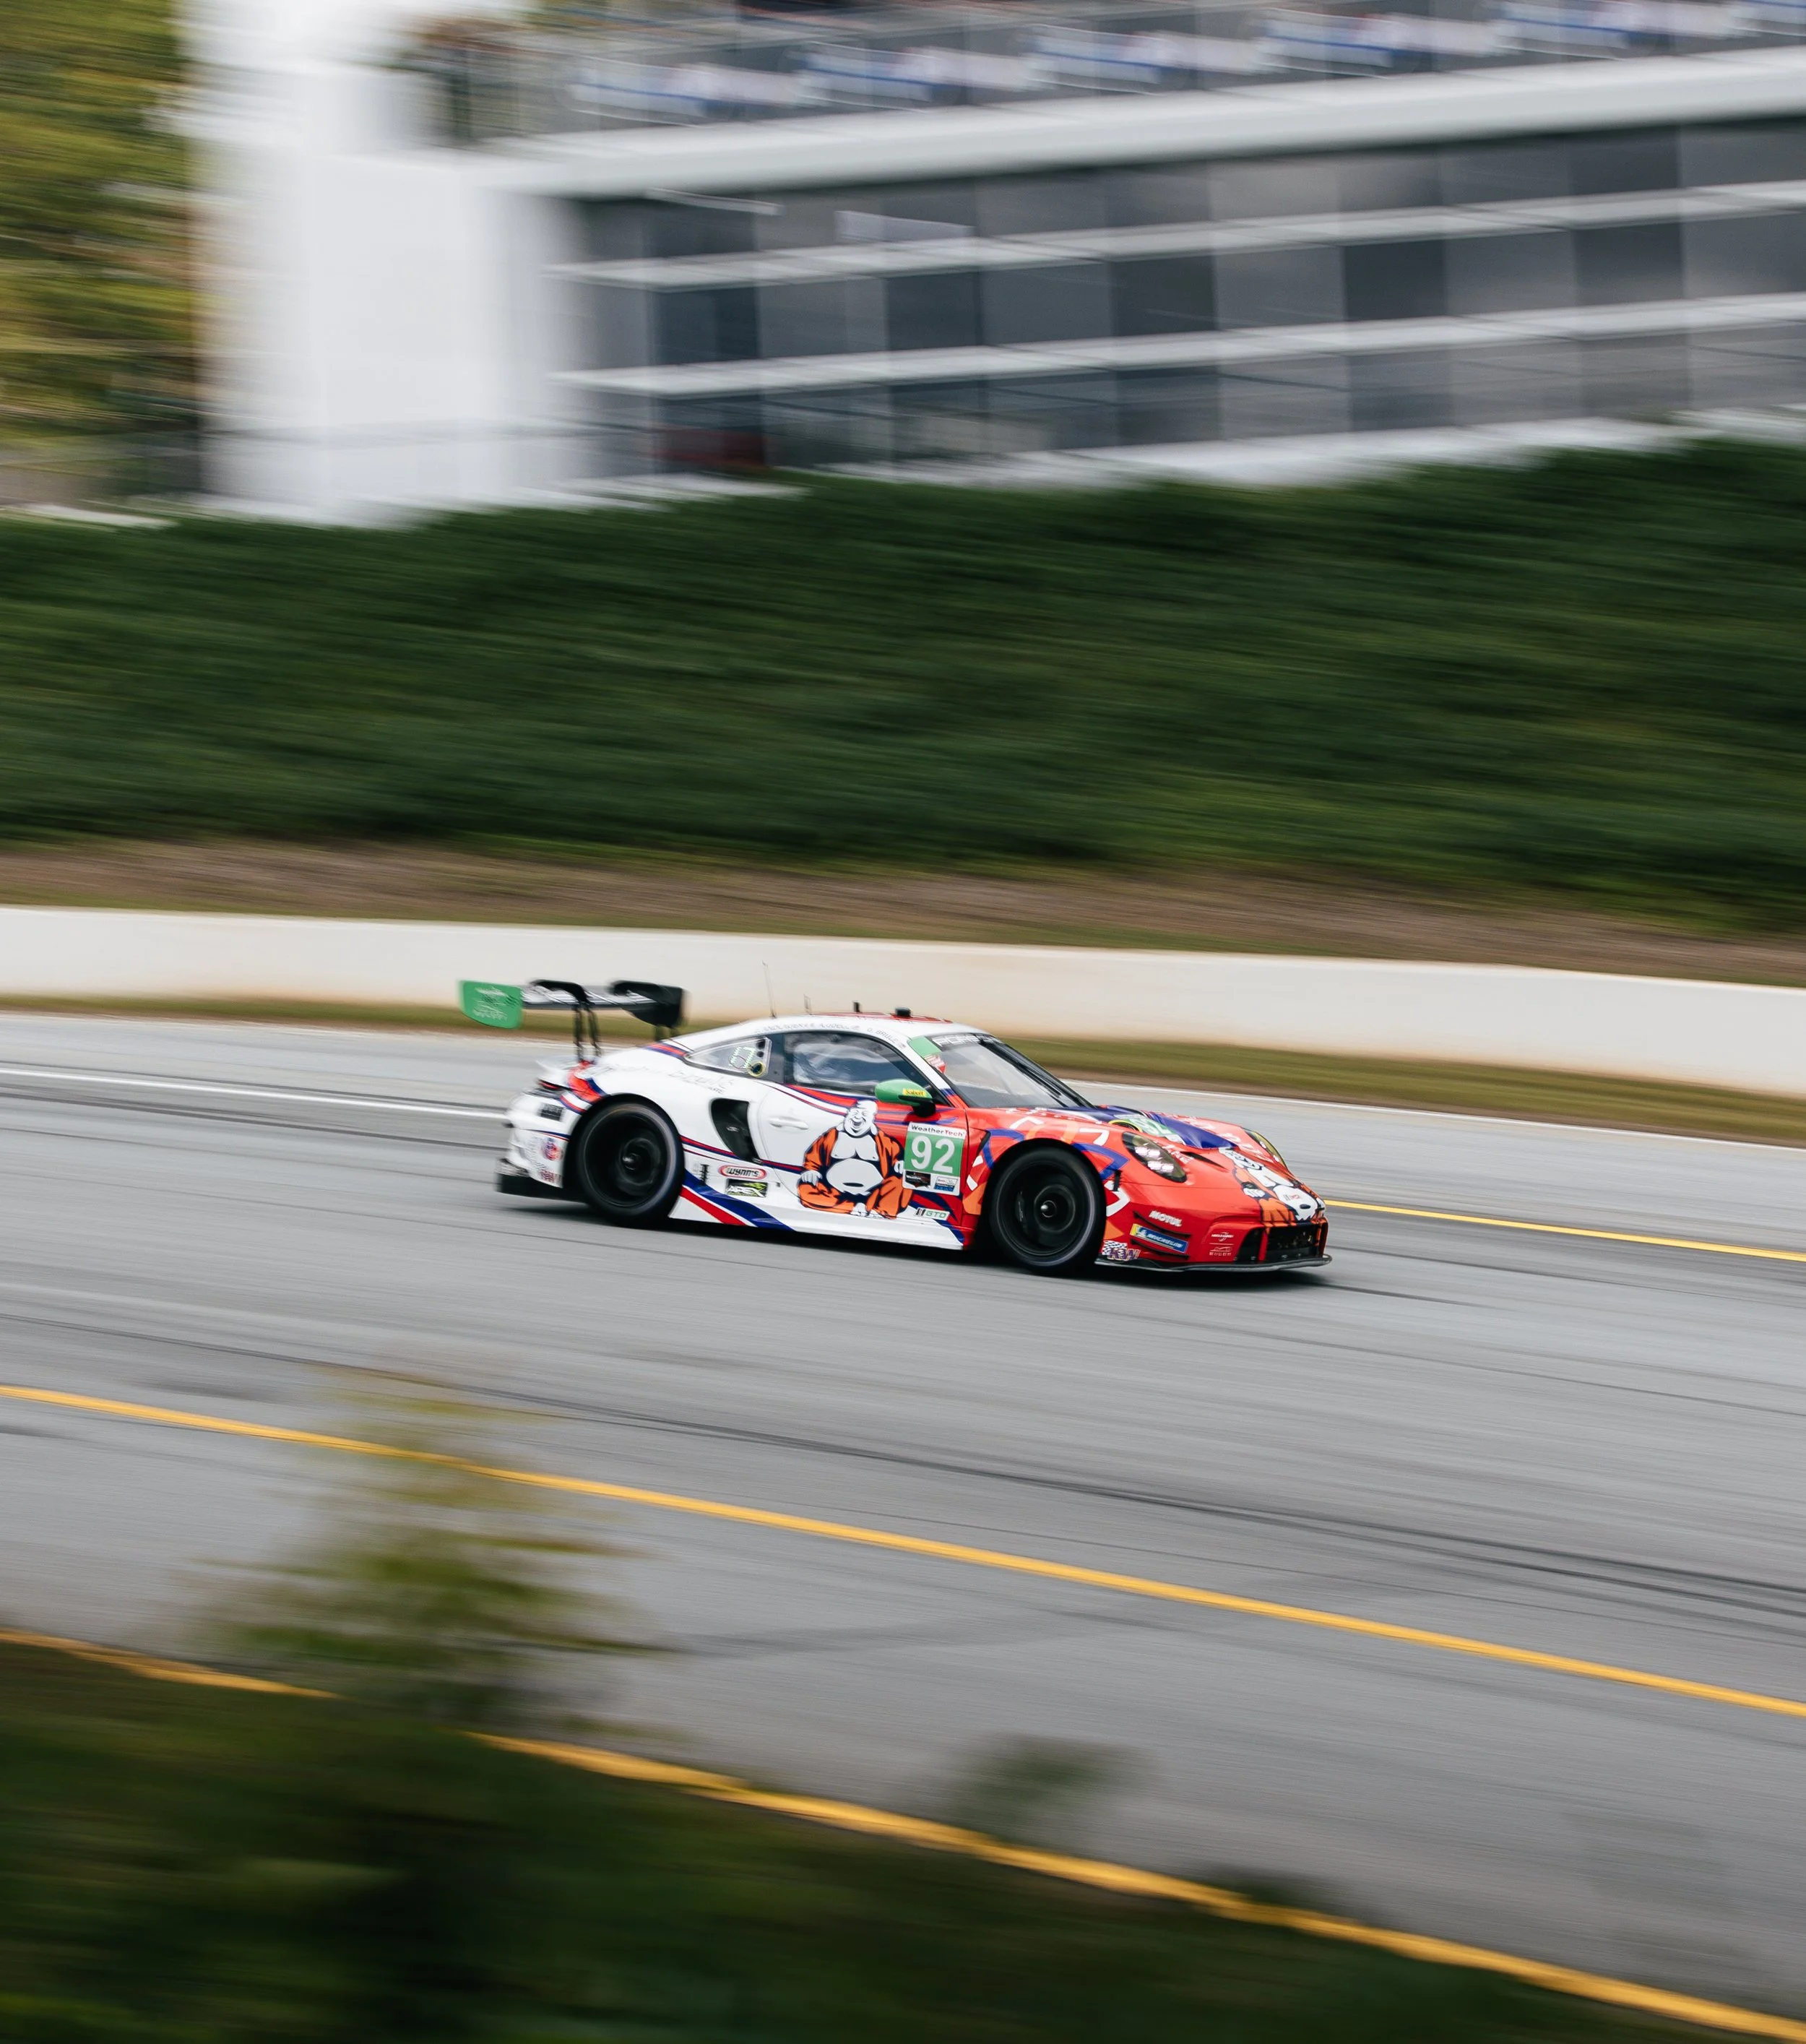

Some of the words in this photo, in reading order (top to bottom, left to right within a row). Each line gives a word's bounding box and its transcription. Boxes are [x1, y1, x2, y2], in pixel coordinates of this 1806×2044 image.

[912, 1124, 963, 1137] WeatherTech
[911, 1135, 955, 1174] 92
[925, 1210, 946, 1219] GTD
[1149, 1210, 1183, 1227] MOTUL
